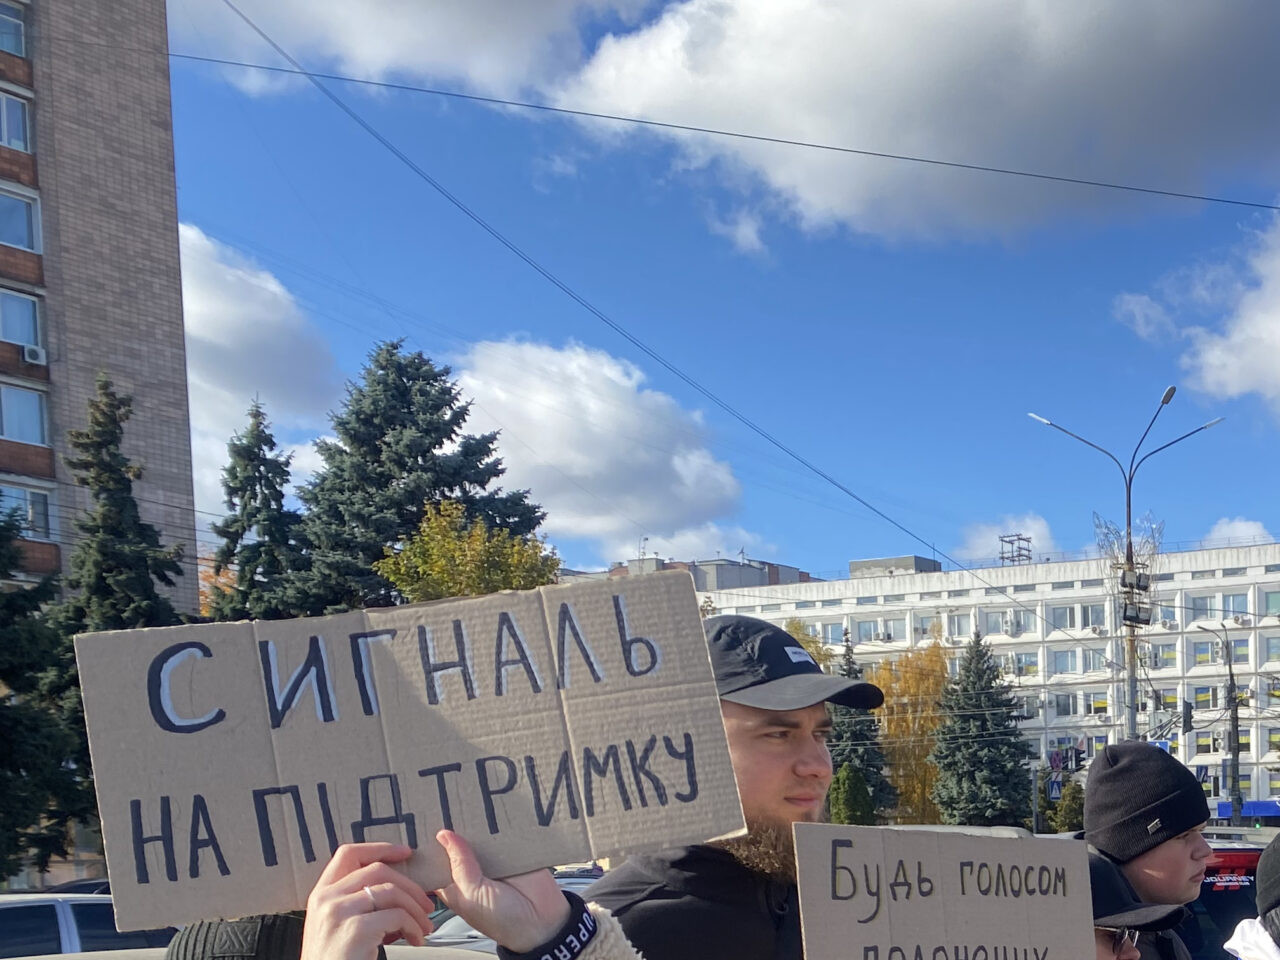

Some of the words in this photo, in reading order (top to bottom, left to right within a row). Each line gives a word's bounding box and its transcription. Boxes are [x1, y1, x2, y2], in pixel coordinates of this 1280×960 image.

[147, 595, 660, 734] СИГНАЛЬ
[130, 793, 231, 884] НА
[251, 731, 700, 868] ПІДТРИМКУ
[830, 839, 934, 923] Будь
[959, 861, 1068, 898] голосом
